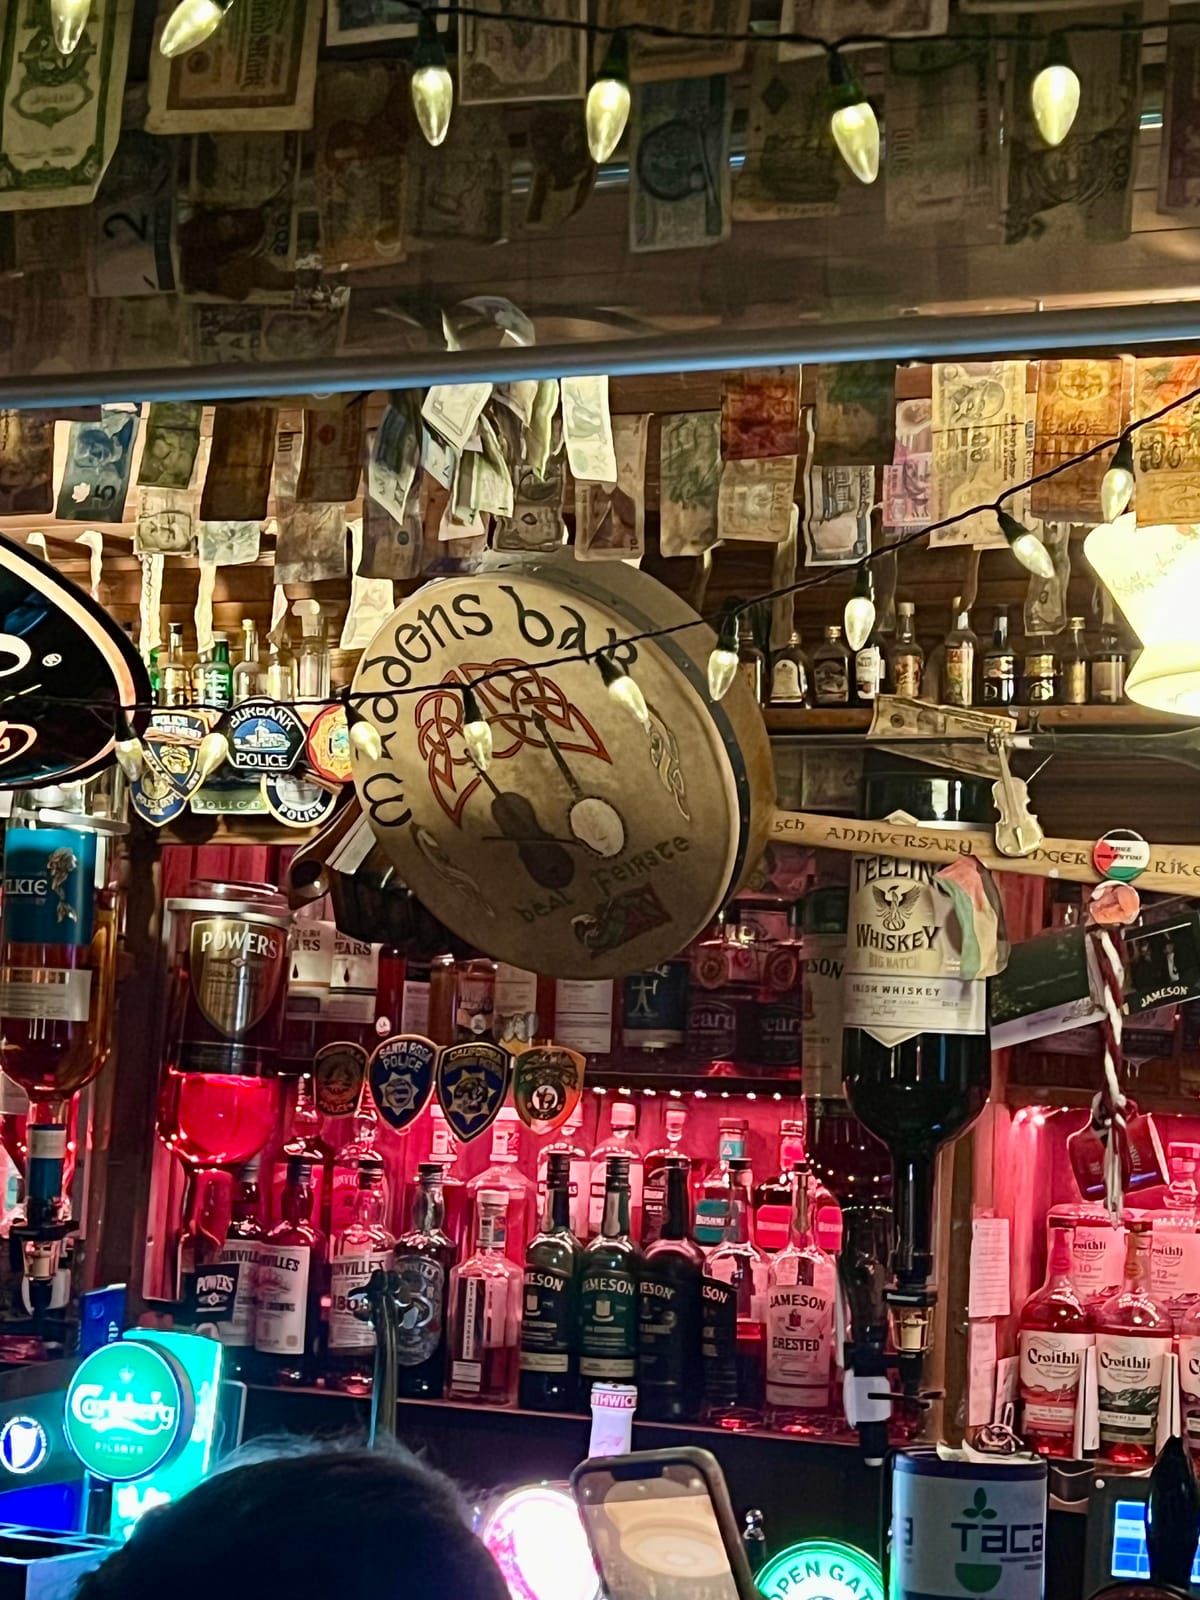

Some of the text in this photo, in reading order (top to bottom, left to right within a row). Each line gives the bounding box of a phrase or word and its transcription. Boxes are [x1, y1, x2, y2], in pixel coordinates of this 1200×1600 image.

[95, 485, 117, 501] 5
[152, 715, 188, 728] POLICE
[230, 705, 296, 732] BURBANK
[235, 752, 289, 768] POLICE
[196, 800, 261, 810] POLICE
[277, 803, 326, 822] POLICE
[201, 930, 278, 960] POWERS
[881, 985, 941, 997] WHISKEY
[1139, 985, 1190, 1009] JAMESON
[383, 1056, 423, 1073] POLICE
[196, 1274, 235, 1294] POWERS
[769, 1294, 826, 1312] JAMESON
[772, 1336, 820, 1352] CRESTED
[1027, 1347, 1080, 1366] Croithli
[1100, 1351, 1151, 1370] Croithli
[71, 1384, 176, 1436] Carlsberg
[768, 1560, 821, 1600] OPEN
